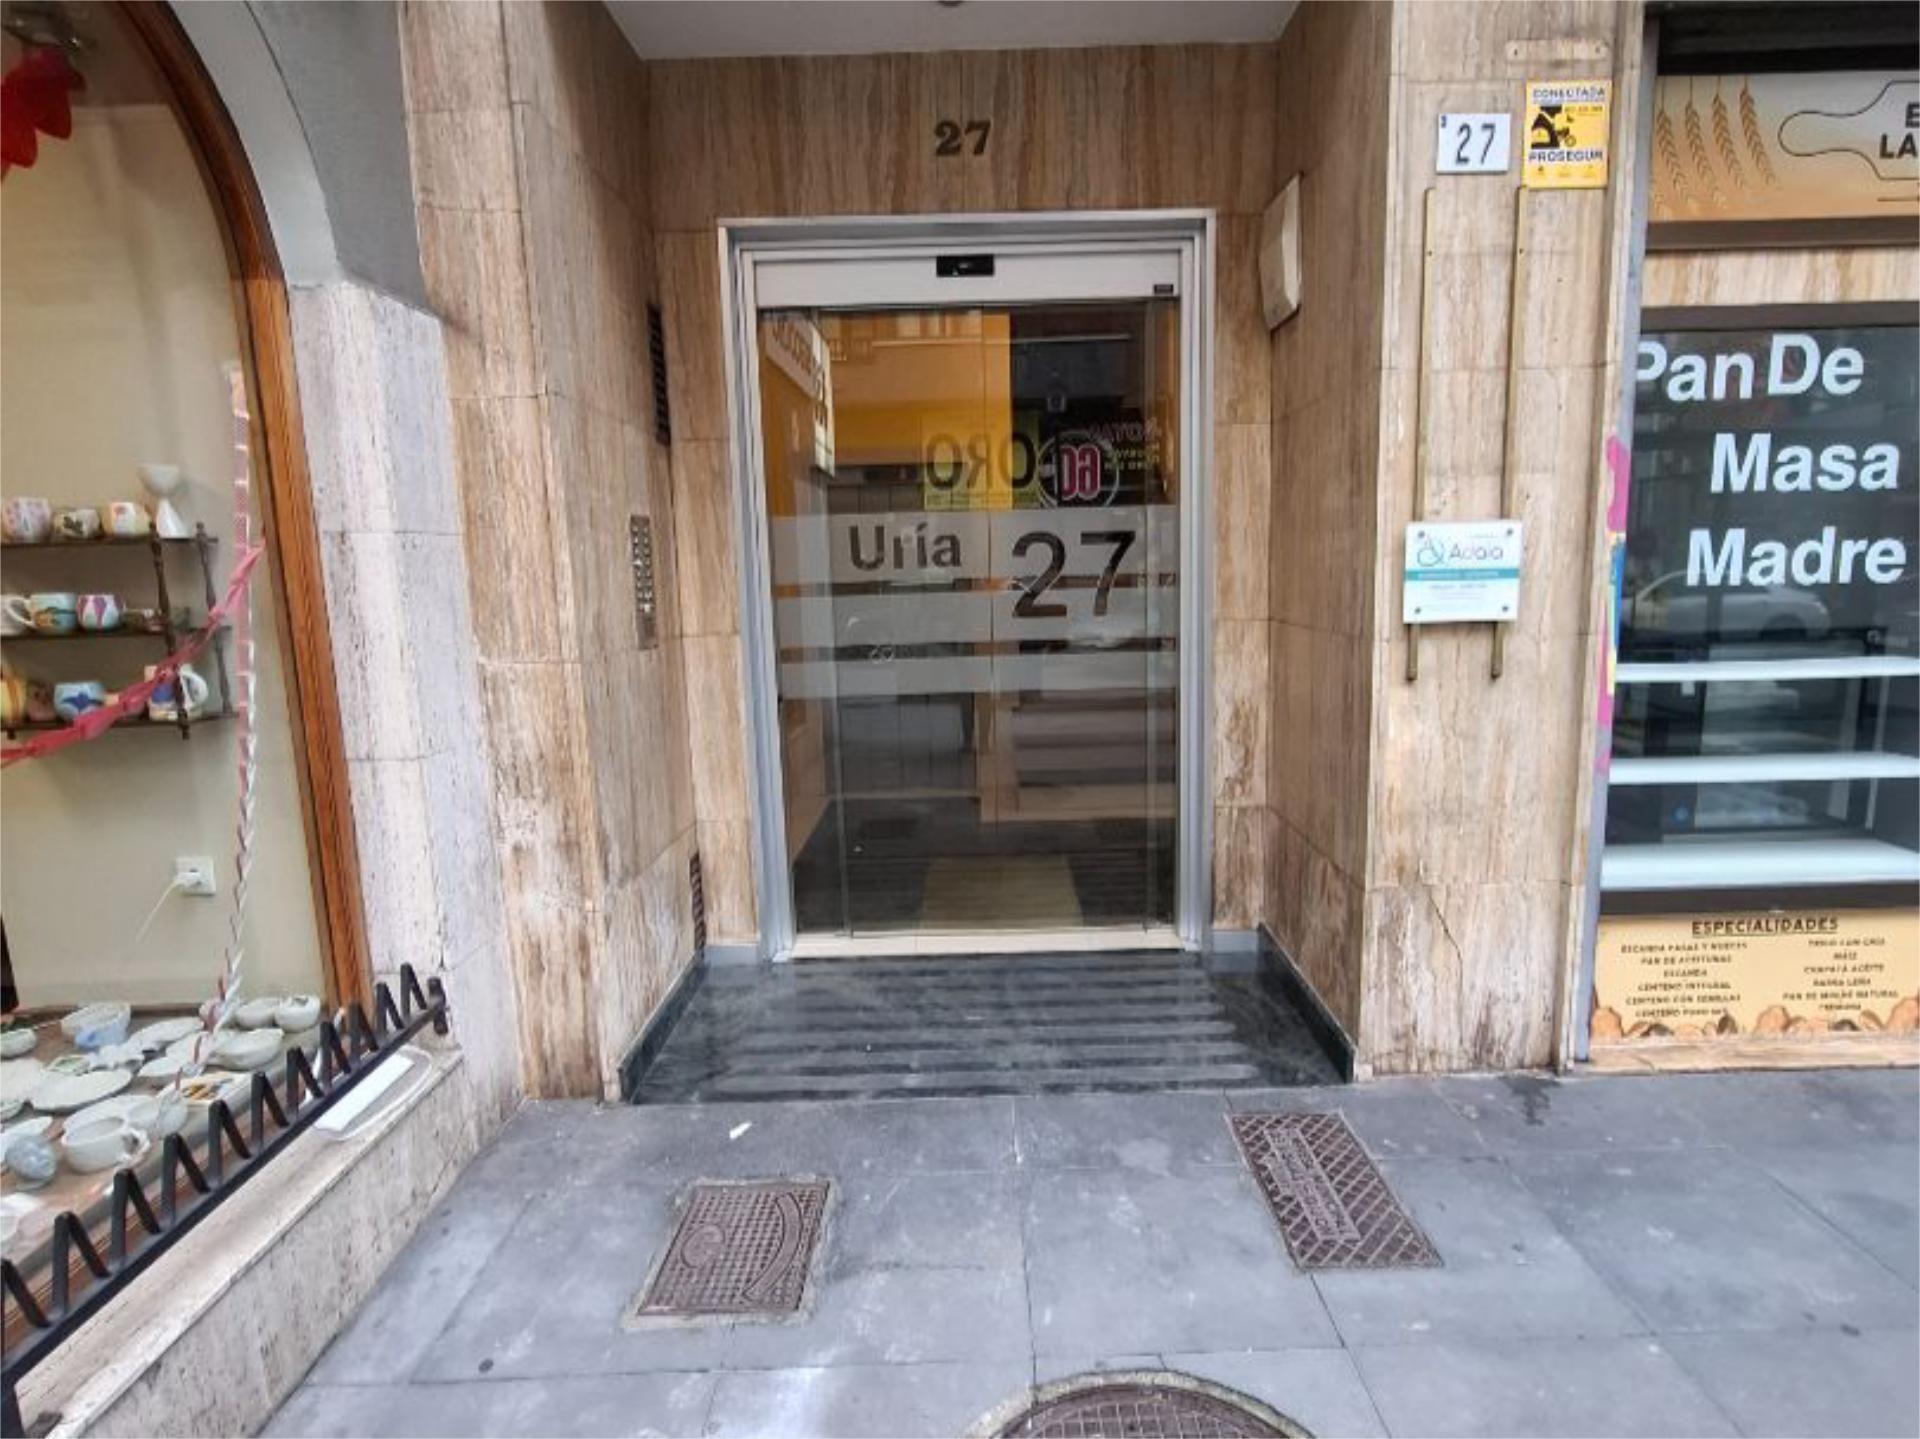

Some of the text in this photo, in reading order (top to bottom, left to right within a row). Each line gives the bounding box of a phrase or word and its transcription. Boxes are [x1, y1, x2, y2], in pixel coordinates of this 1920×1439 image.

[1533, 87, 1605, 98] CONECTADA
[934, 120, 991, 157] 27
[1456, 122, 1496, 165] 27
[1529, 151, 1603, 162] PROSEGUR
[1635, 333, 1865, 401] Pan De
[1711, 433, 1900, 493] Masa
[849, 522, 1136, 618] Uría 27
[1686, 526, 1907, 587] Madre
[1692, 917, 1839, 934] ESPECIALIDADES
